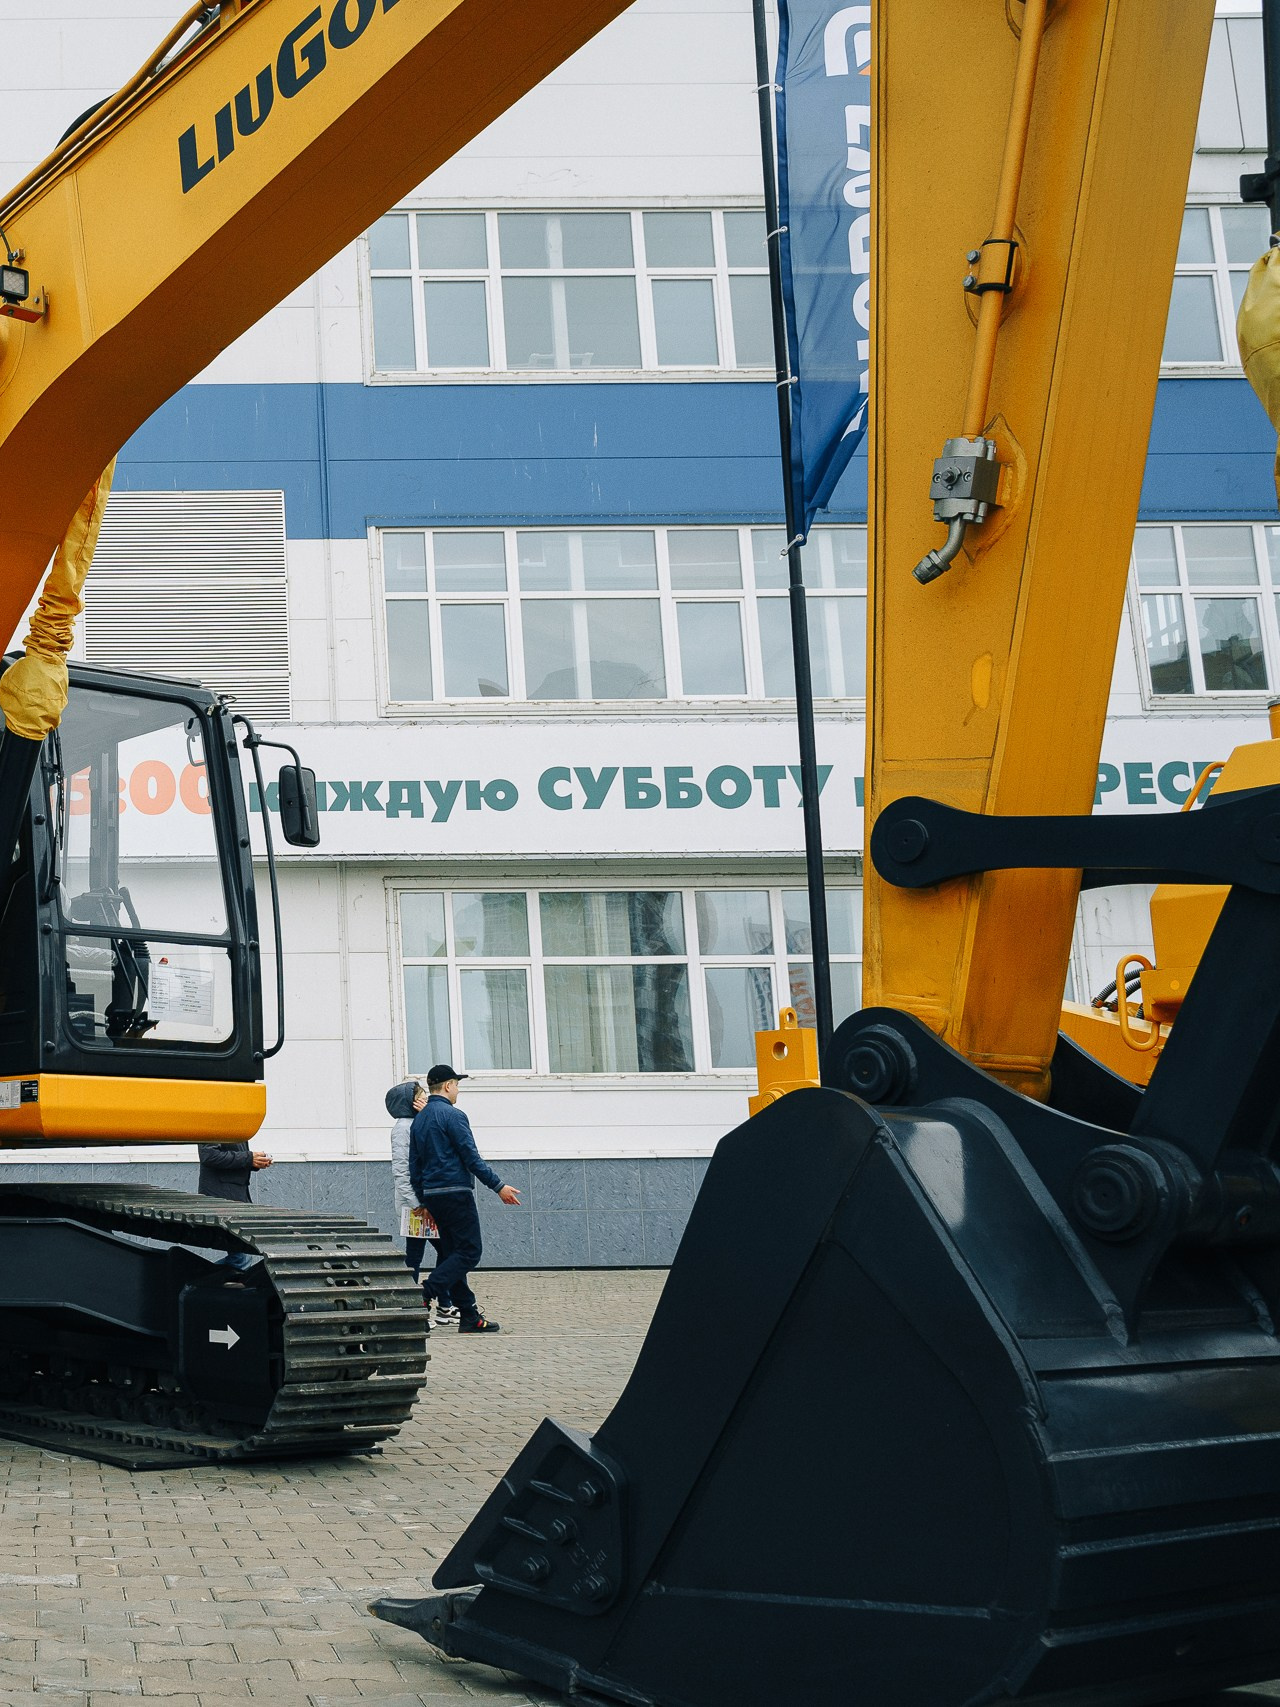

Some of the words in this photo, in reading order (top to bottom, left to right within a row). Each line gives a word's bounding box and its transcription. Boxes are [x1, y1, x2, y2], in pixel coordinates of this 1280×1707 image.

[178, 0, 401, 194] LIUGO
[249, 778, 518, 823] кждую
[537, 765, 834, 811] СУББОТУ
